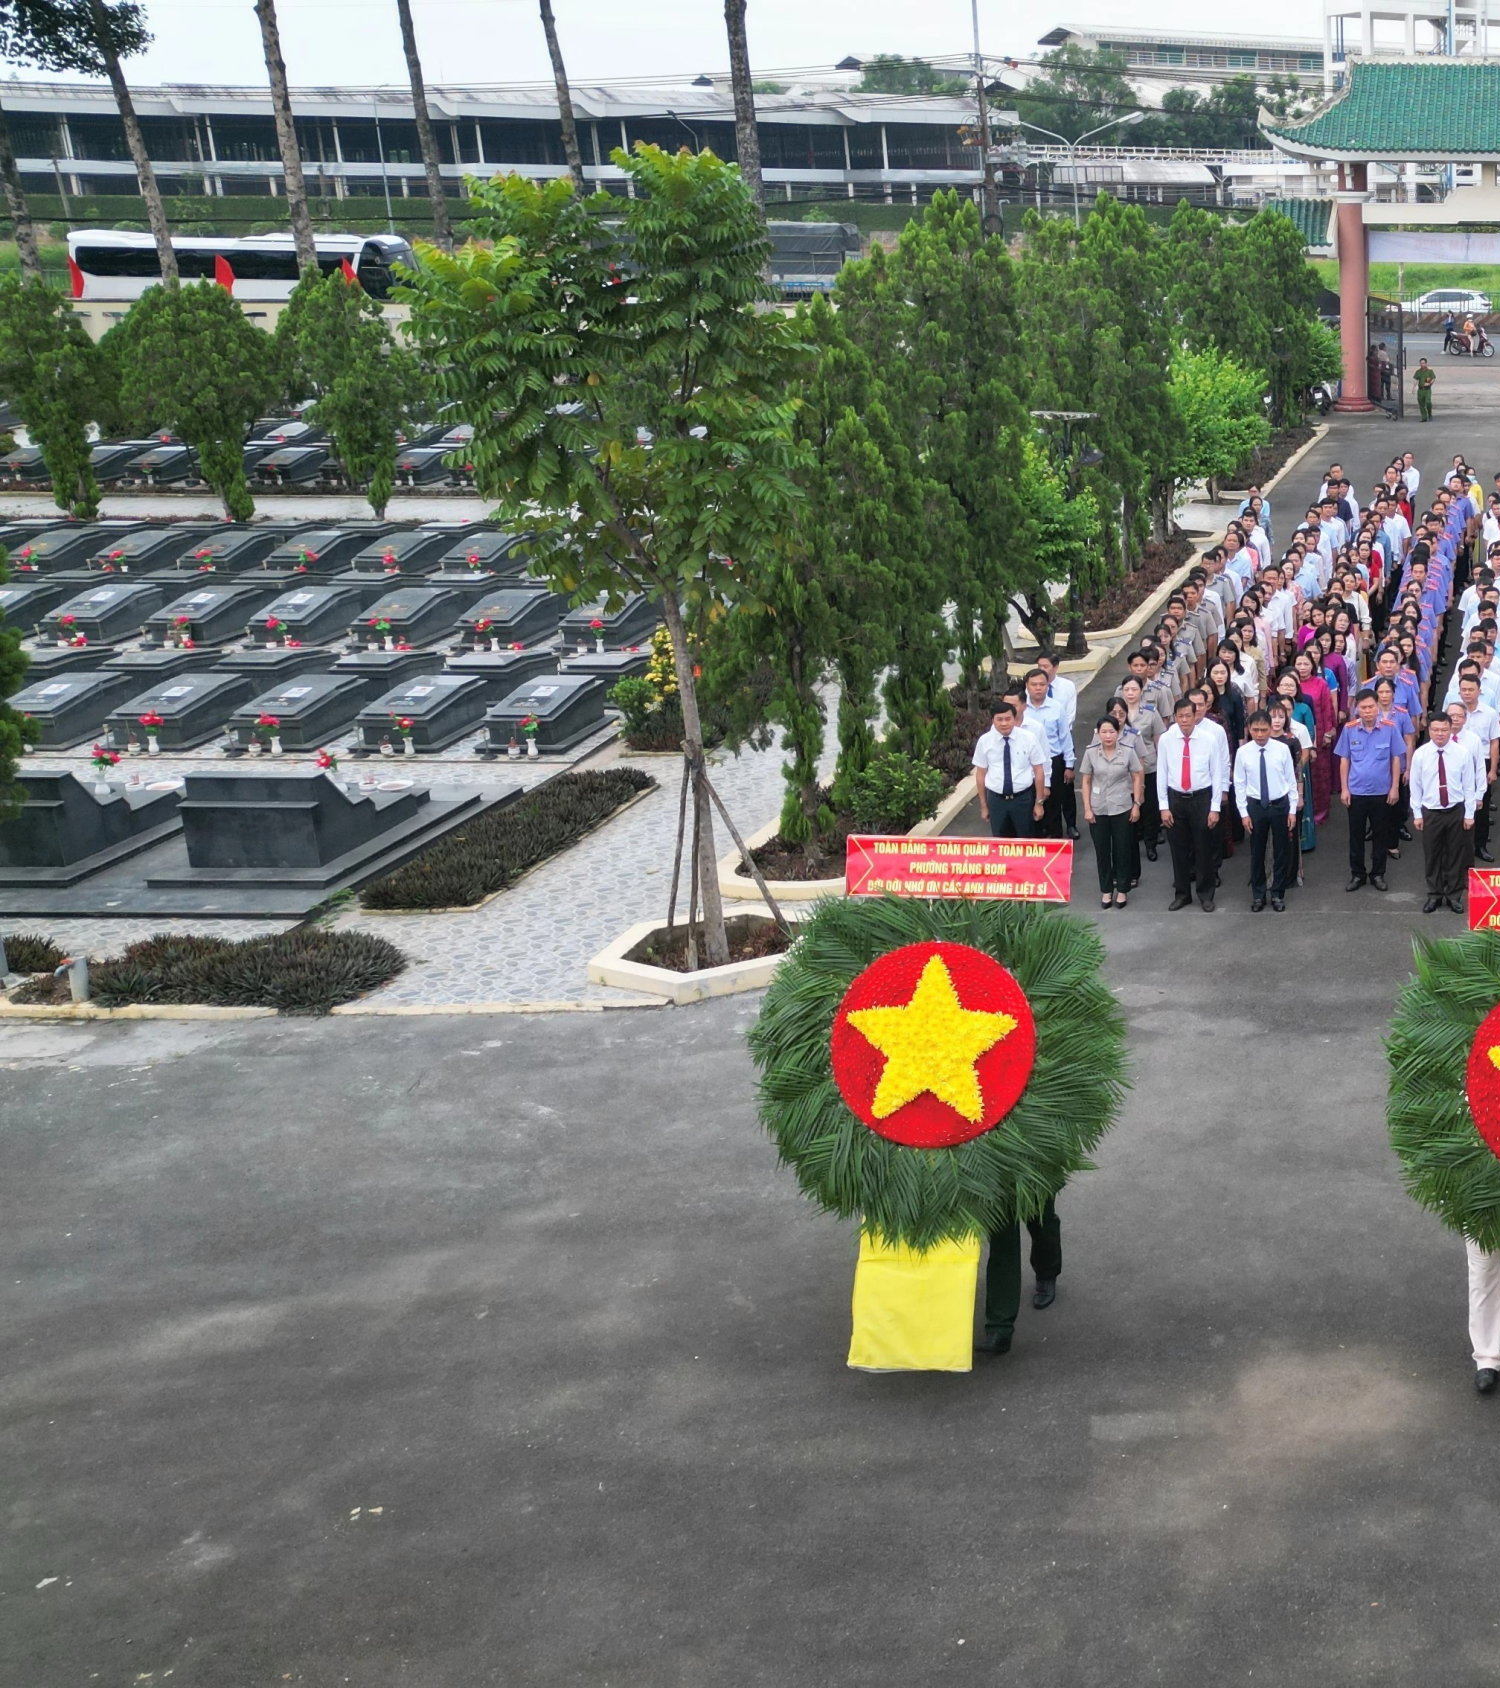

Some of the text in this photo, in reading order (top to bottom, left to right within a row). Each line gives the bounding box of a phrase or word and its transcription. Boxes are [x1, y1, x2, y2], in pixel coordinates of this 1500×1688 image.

[873, 840, 899, 854] TOÀN
[900, 839, 927, 855] ĐẢNG
[935, 841, 961, 855] TOÀN
[963, 842, 990, 857] QUÂN
[998, 843, 1024, 857] TOÀN
[1025, 843, 1046, 858] DÂN
[909, 859, 1007, 876] PHƯỜNG TRẢNG BOM
[942, 879, 962, 893] CÁC
[964, 881, 985, 894] ANH
[986, 880, 1013, 894] HÙNG
[1015, 881, 1035, 897] LIỆT
[1036, 881, 1048, 895] SĨ
